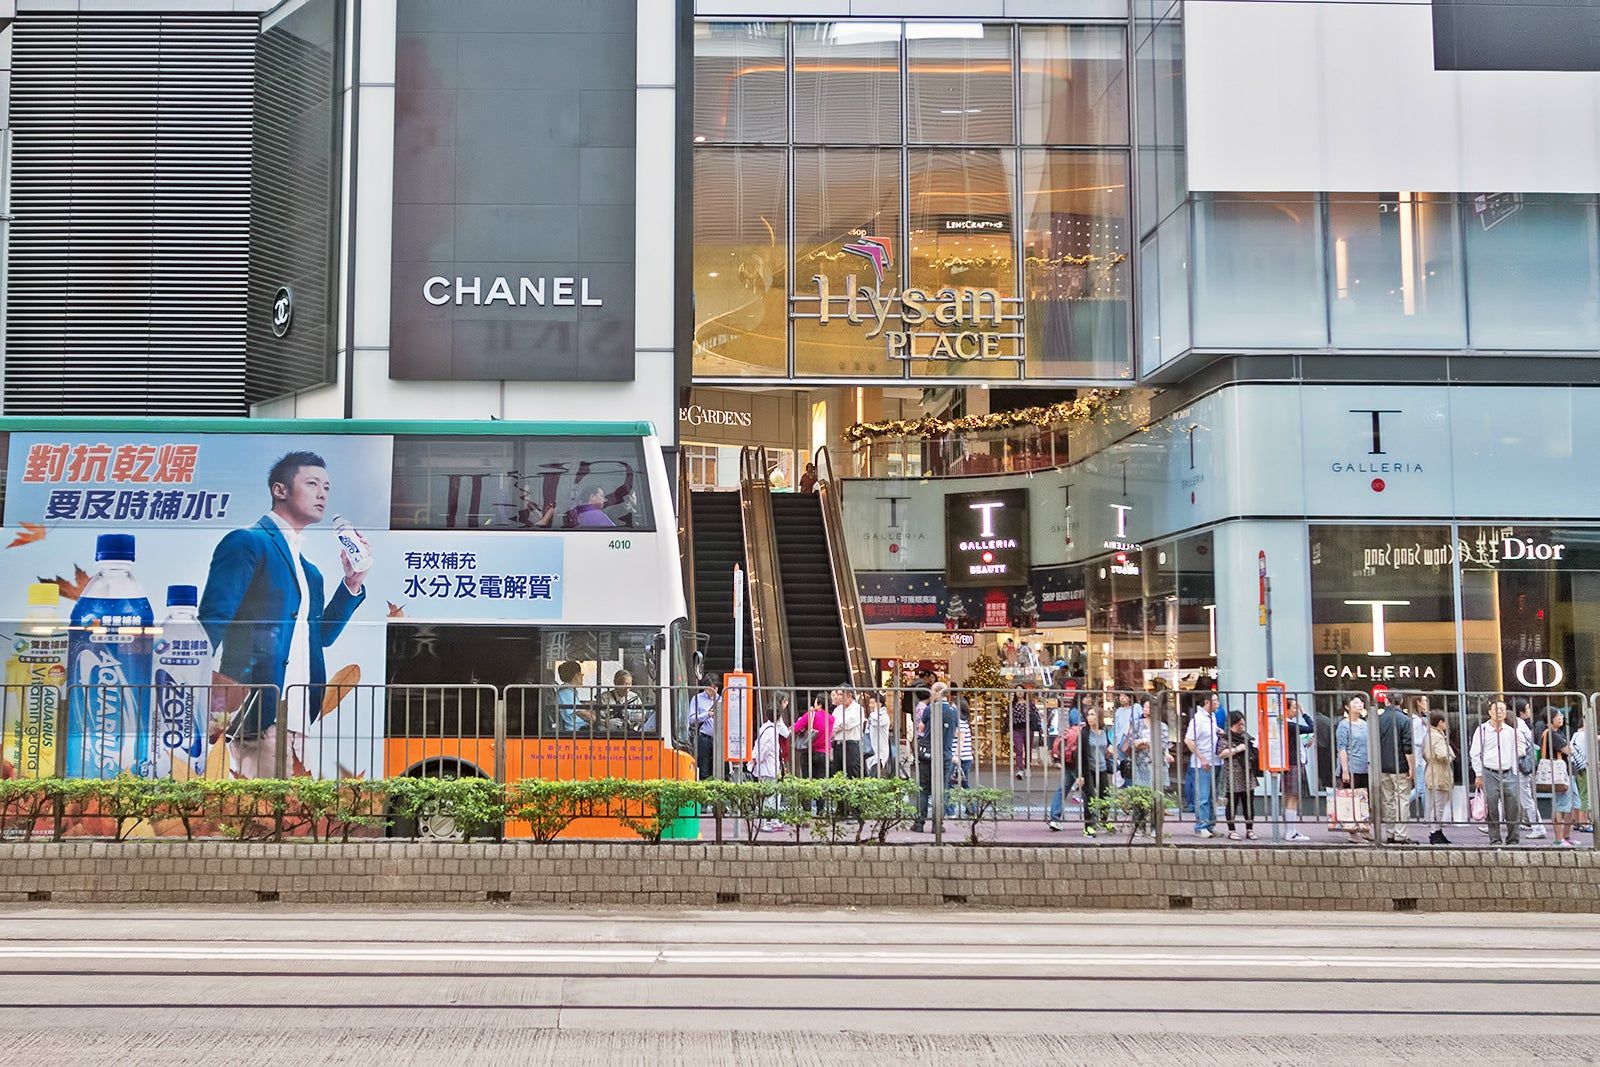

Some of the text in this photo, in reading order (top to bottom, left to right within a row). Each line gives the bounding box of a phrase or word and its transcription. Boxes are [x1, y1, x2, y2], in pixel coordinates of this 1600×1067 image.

[422, 276, 603, 306] CHANEL
[812, 274, 1002, 340] Hysan
[884, 330, 1002, 360] PLACE
[1349, 409, 1402, 455] T
[22, 443, 199, 483] 對抗乾燥
[1331, 462, 1424, 473] GALLERIA
[45, 490, 230, 520] 要及時補水!
[969, 502, 1004, 537] T
[608, 540, 631, 550] 4010
[959, 539, 1016, 551] GALLERIA
[1501, 538, 1566, 560] Dior
[404, 551, 477, 570] 有效補充
[969, 564, 1007, 575] BEAUTY
[1344, 600, 1410, 657] T
[1323, 664, 1436, 678] GALLERIA
[43, 687, 57, 748] AQUARIUS
[94, 650, 122, 772] AQUARIUS
